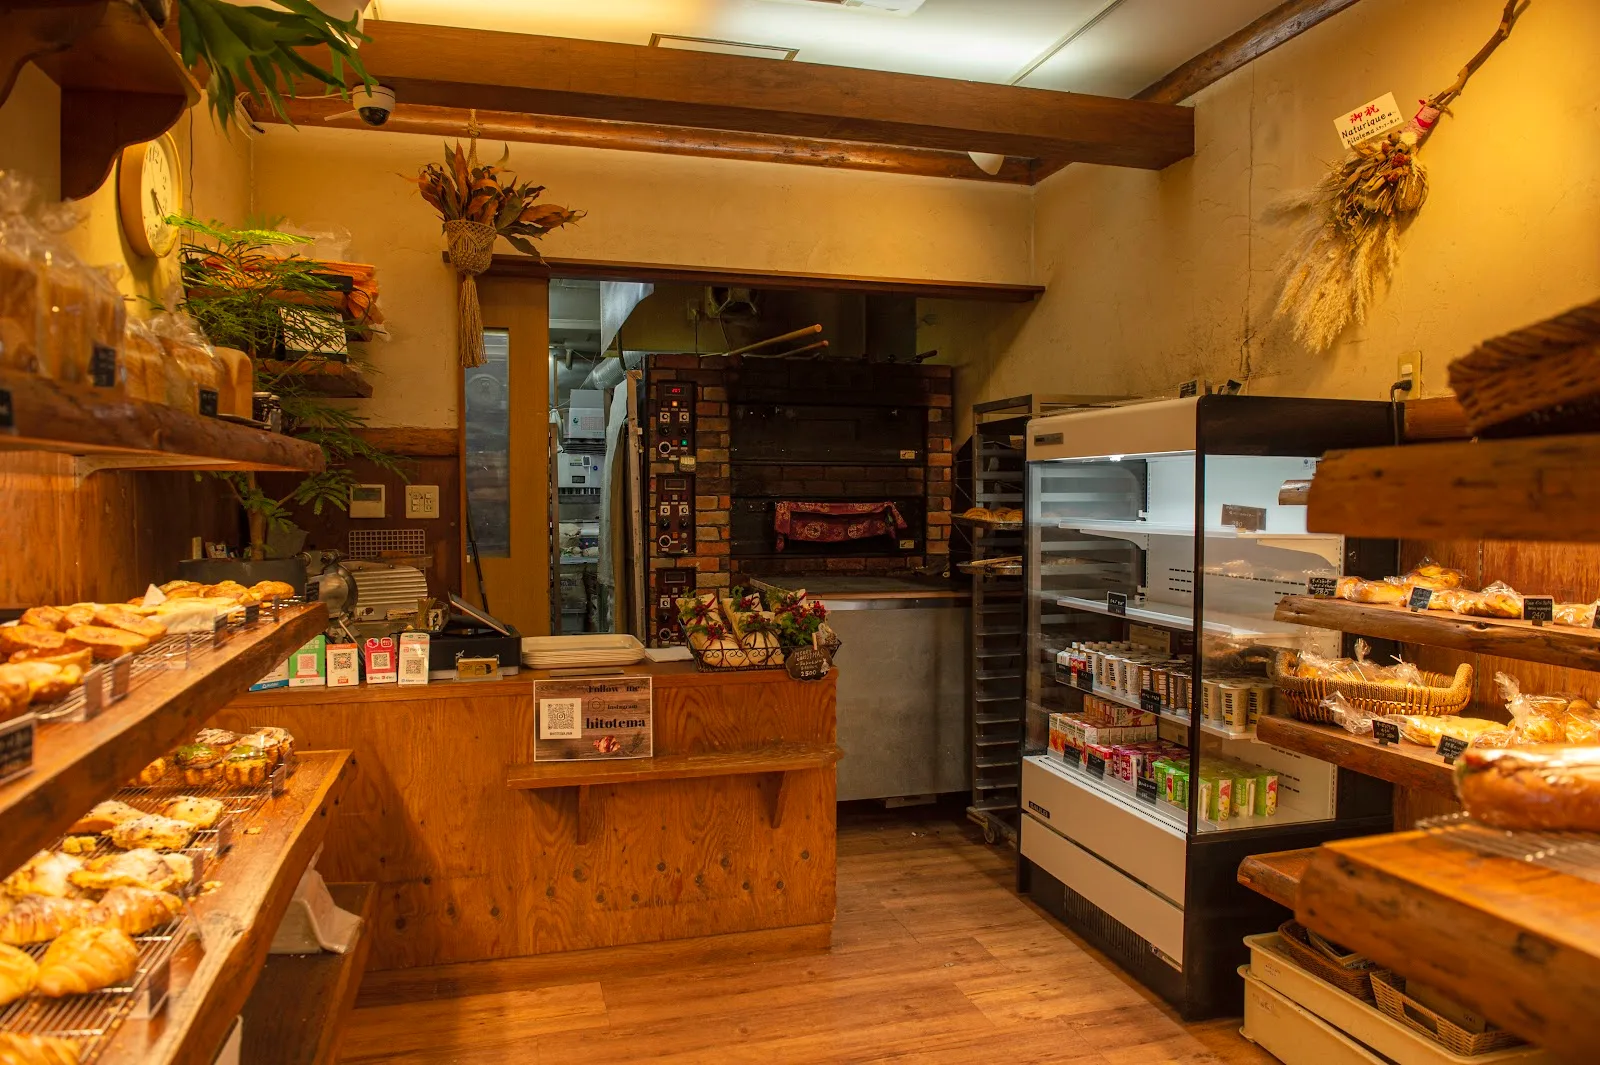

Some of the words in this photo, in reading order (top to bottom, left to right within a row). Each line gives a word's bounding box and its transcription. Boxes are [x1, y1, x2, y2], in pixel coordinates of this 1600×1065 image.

[1350, 104, 1379, 123] 御祝
[1341, 113, 1386, 138] Naturique
[1532, 611, 1546, 620] 240
[800, 669, 817, 677] 2500
[587, 684, 619, 693] Follow
[586, 717, 645, 729] hitotema
